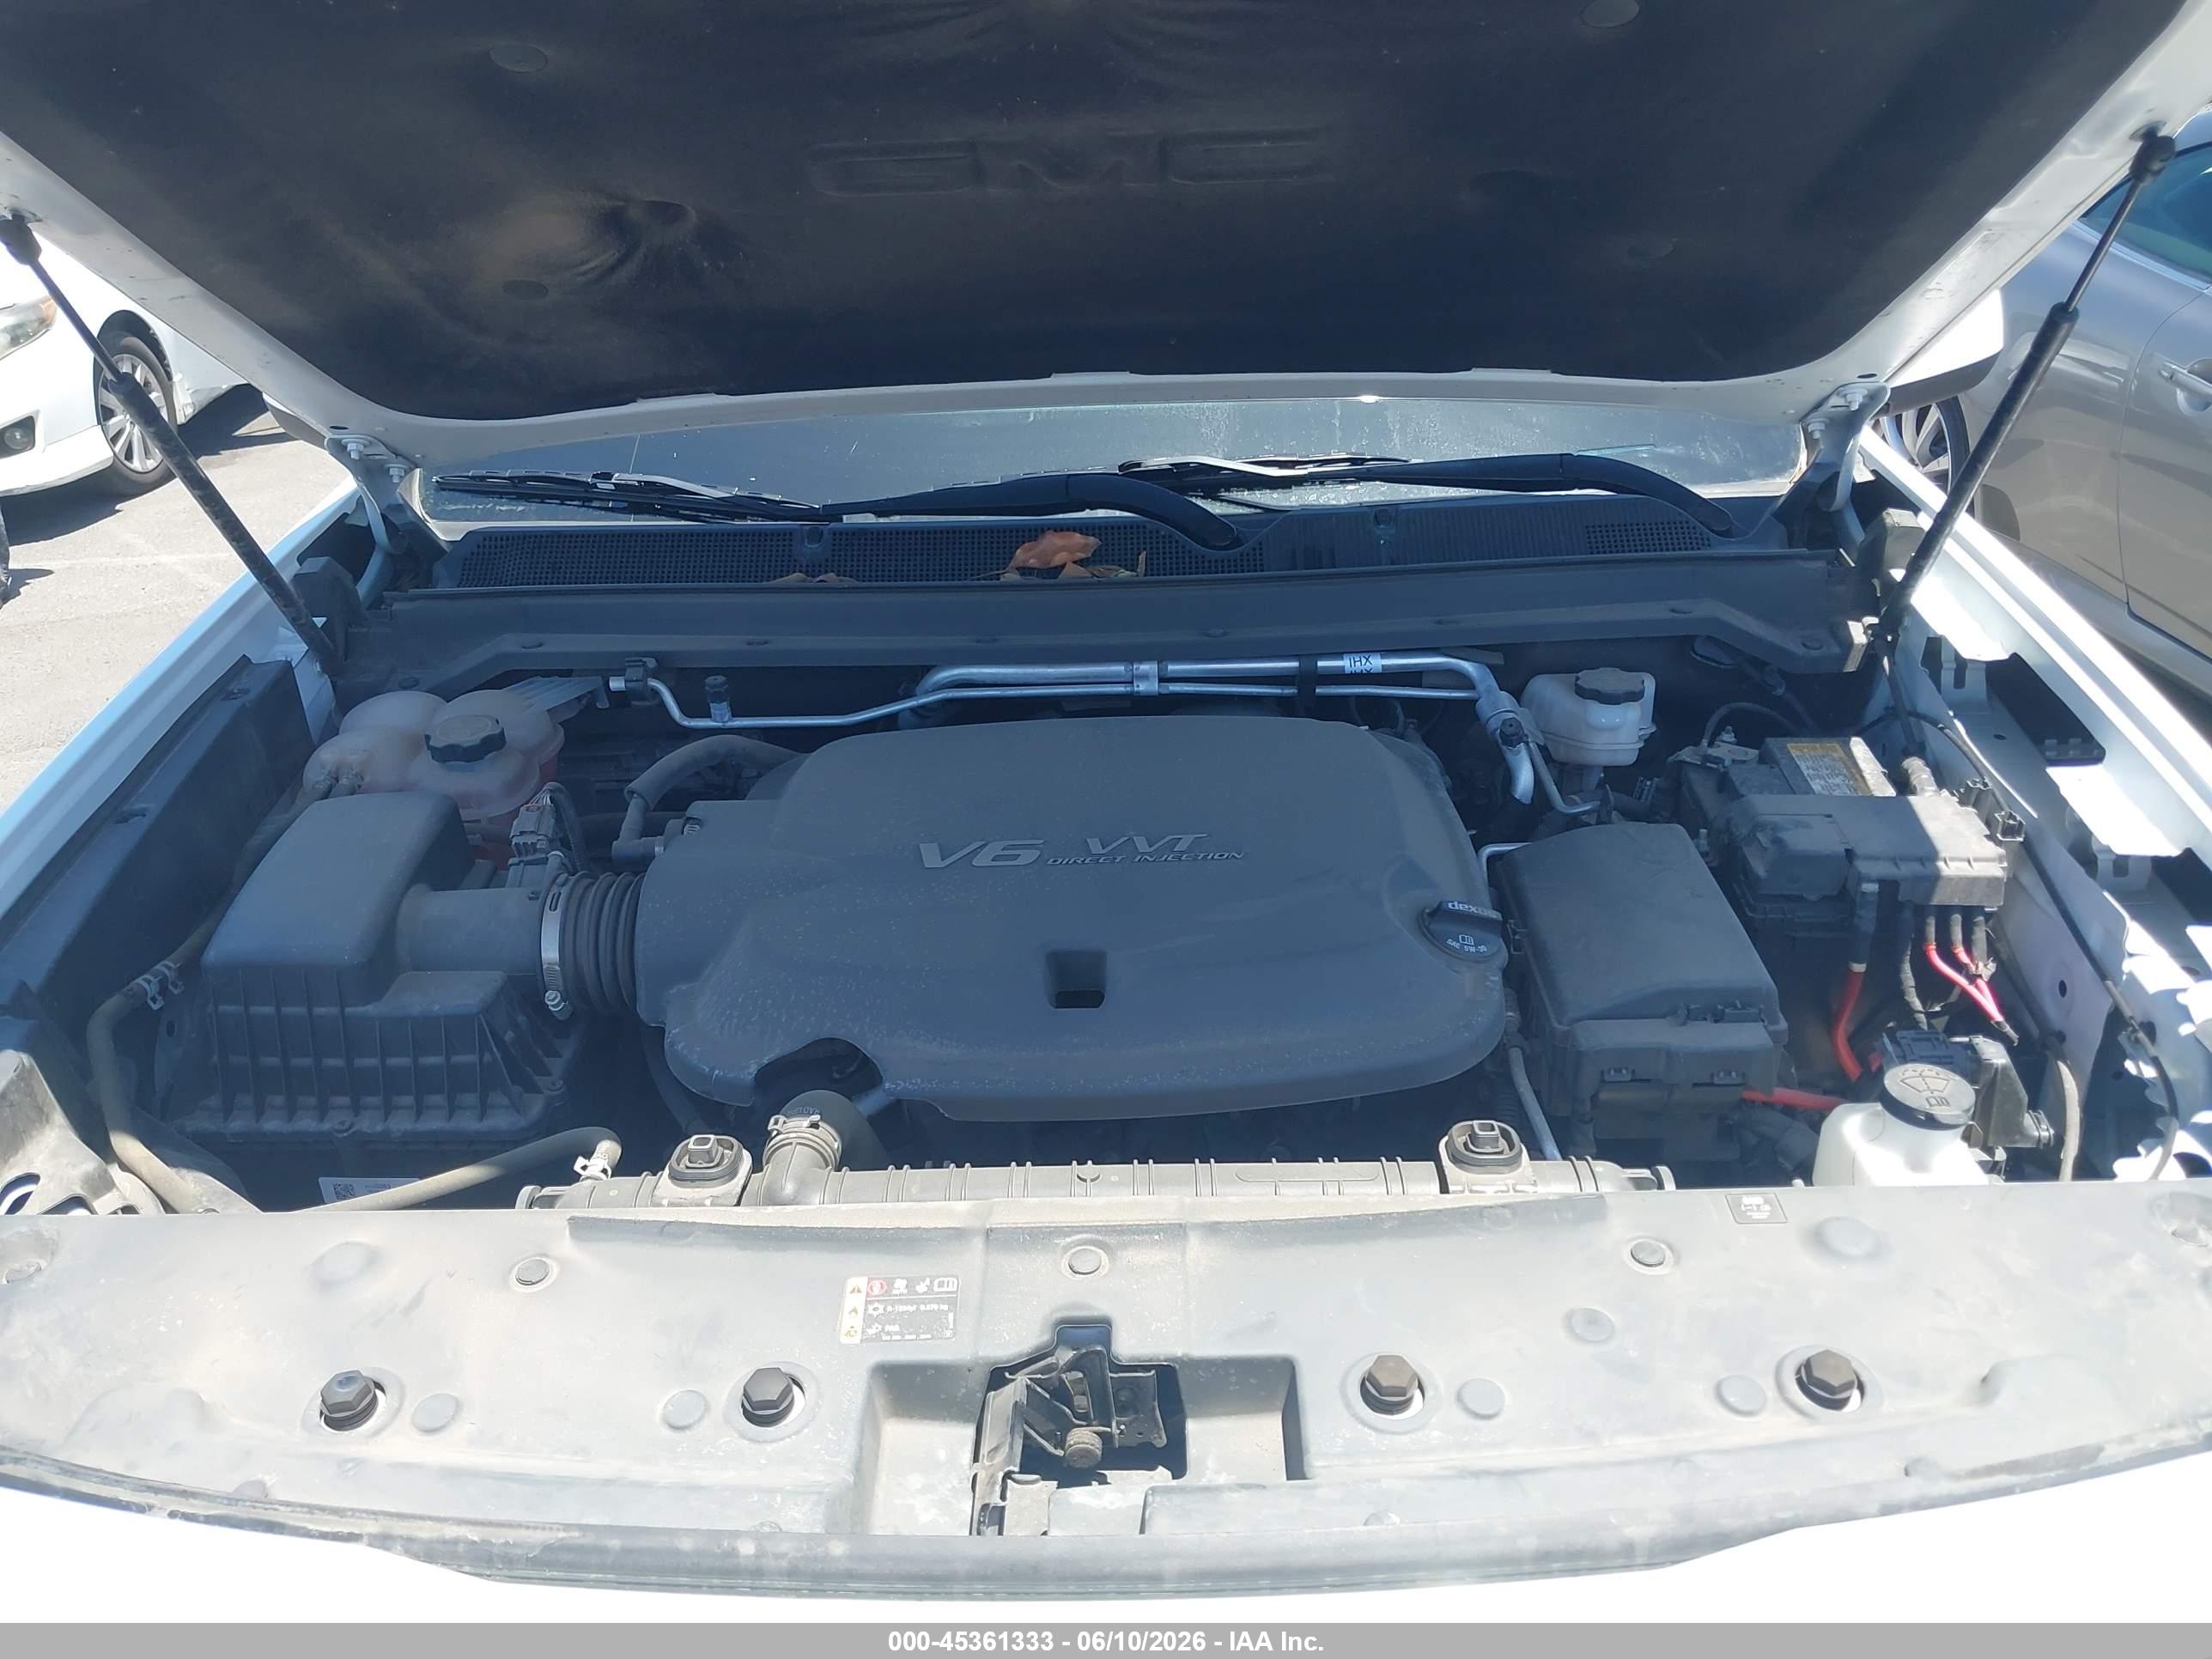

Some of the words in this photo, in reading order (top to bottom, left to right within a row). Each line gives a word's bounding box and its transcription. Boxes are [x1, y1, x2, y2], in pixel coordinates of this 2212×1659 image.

[1348, 654, 1373, 669] IHX
[919, 839, 1045, 869] V6
[1085, 833, 1209, 854] VVT
[1046, 854, 1127, 866] DIRECT
[1133, 850, 1244, 863] INJECTION
